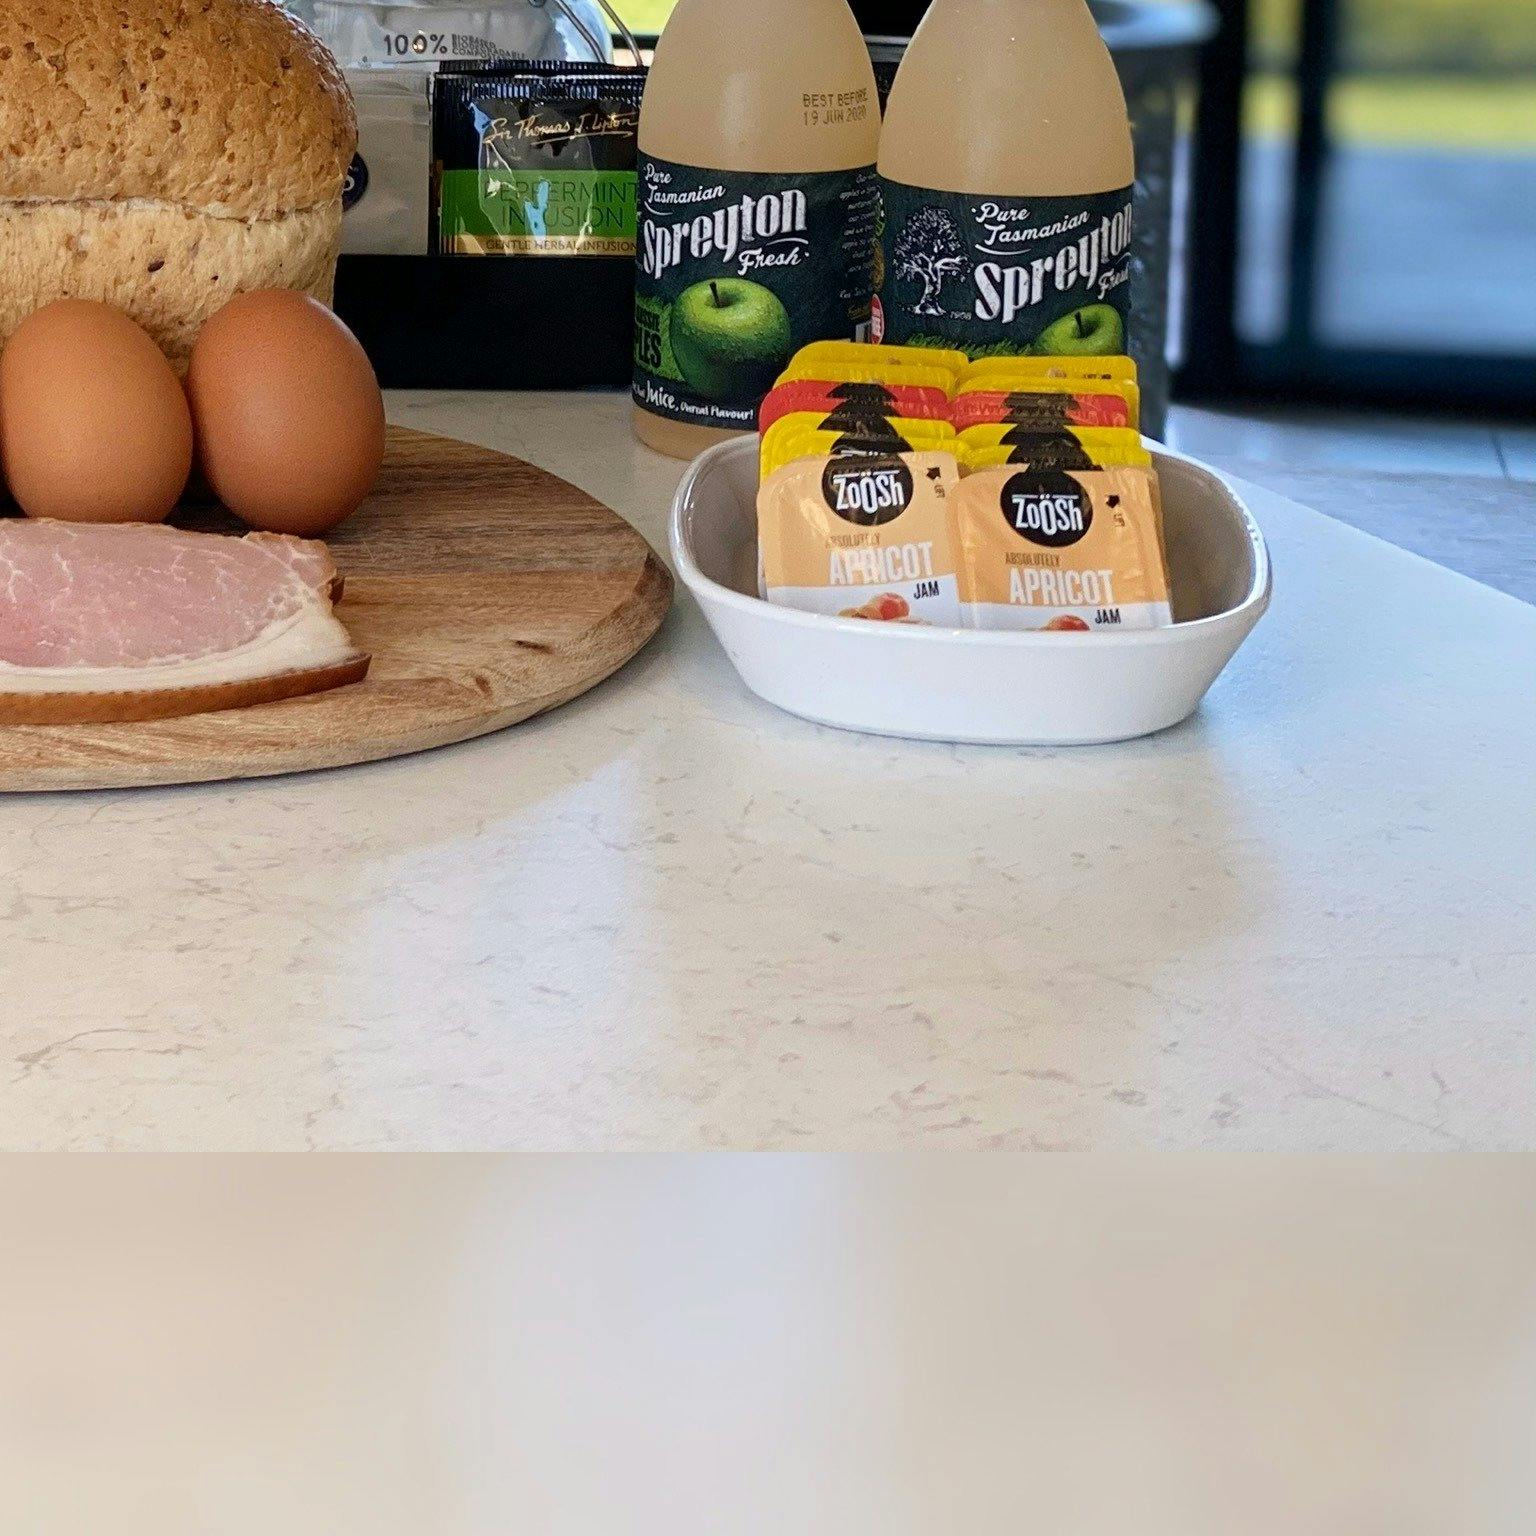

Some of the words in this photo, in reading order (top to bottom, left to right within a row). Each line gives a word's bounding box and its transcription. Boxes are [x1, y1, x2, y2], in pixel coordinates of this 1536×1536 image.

[383, 33, 447, 56] 100%
[803, 93, 834, 108] BEST
[514, 114, 571, 139] Thomas
[592, 112, 638, 133] Lipton
[803, 110, 819, 125] 19
[823, 109, 844, 124] JUN
[643, 163, 672, 184] Pure
[647, 183, 726, 205] Tasmanian
[501, 206, 623, 229] INUSION
[975, 202, 1030, 223] Pure
[643, 188, 807, 280] Spreyton
[984, 210, 1090, 246] Tasmanian
[737, 247, 802, 276] Fresh
[974, 202, 1132, 324] Spreyton
[646, 379, 680, 412] Juice,
[710, 405, 754, 421] Flavour!
[829, 541, 934, 585] APRICOT
[1005, 552, 1061, 567] ABSOLUTELY
[913, 580, 940, 600] JAM
[1009, 566, 1114, 606] APRICOT
[1095, 608, 1122, 624] JAM
